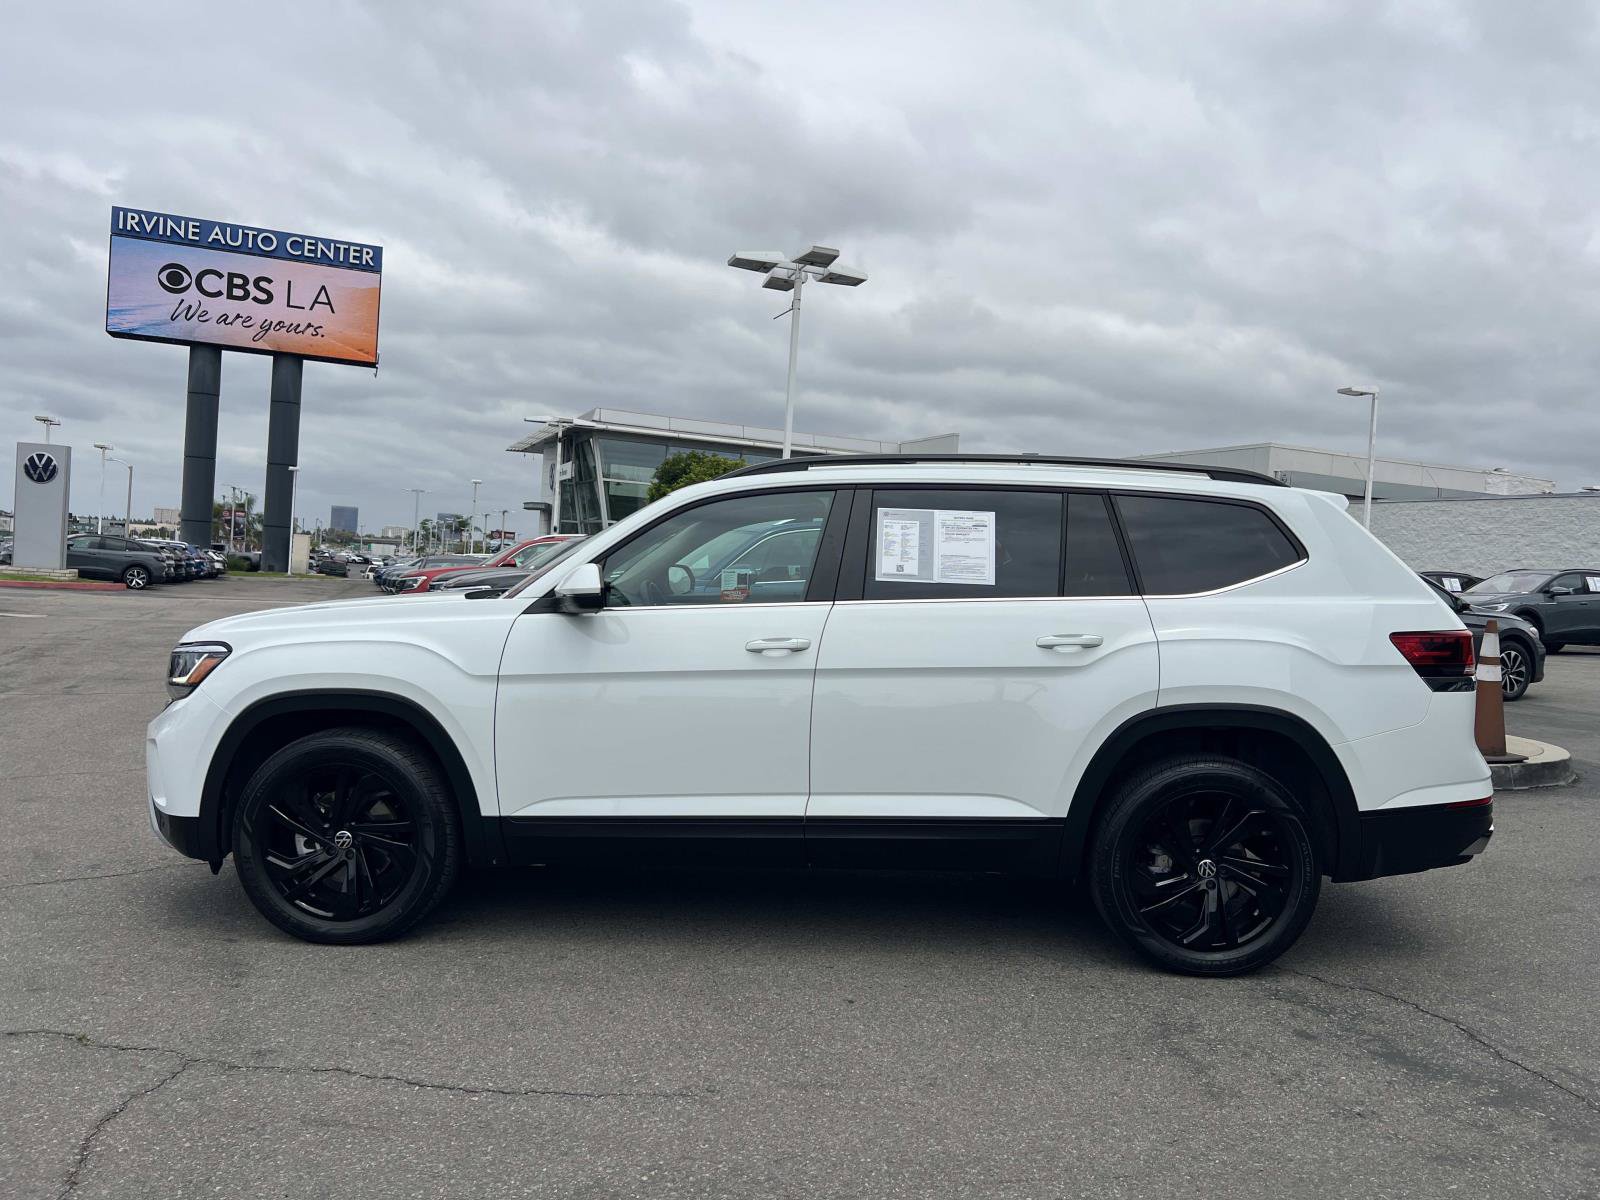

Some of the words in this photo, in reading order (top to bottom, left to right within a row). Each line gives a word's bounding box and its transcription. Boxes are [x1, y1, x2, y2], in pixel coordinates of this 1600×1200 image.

[118, 210, 201, 241] IRVINE
[207, 225, 278, 251] AUTO
[286, 236, 375, 267] CENTER
[194, 268, 274, 305] CBS
[286, 280, 336, 314] LA
[170, 298, 213, 323] We
[216, 310, 255, 328] are
[251, 318, 325, 342] yours.
